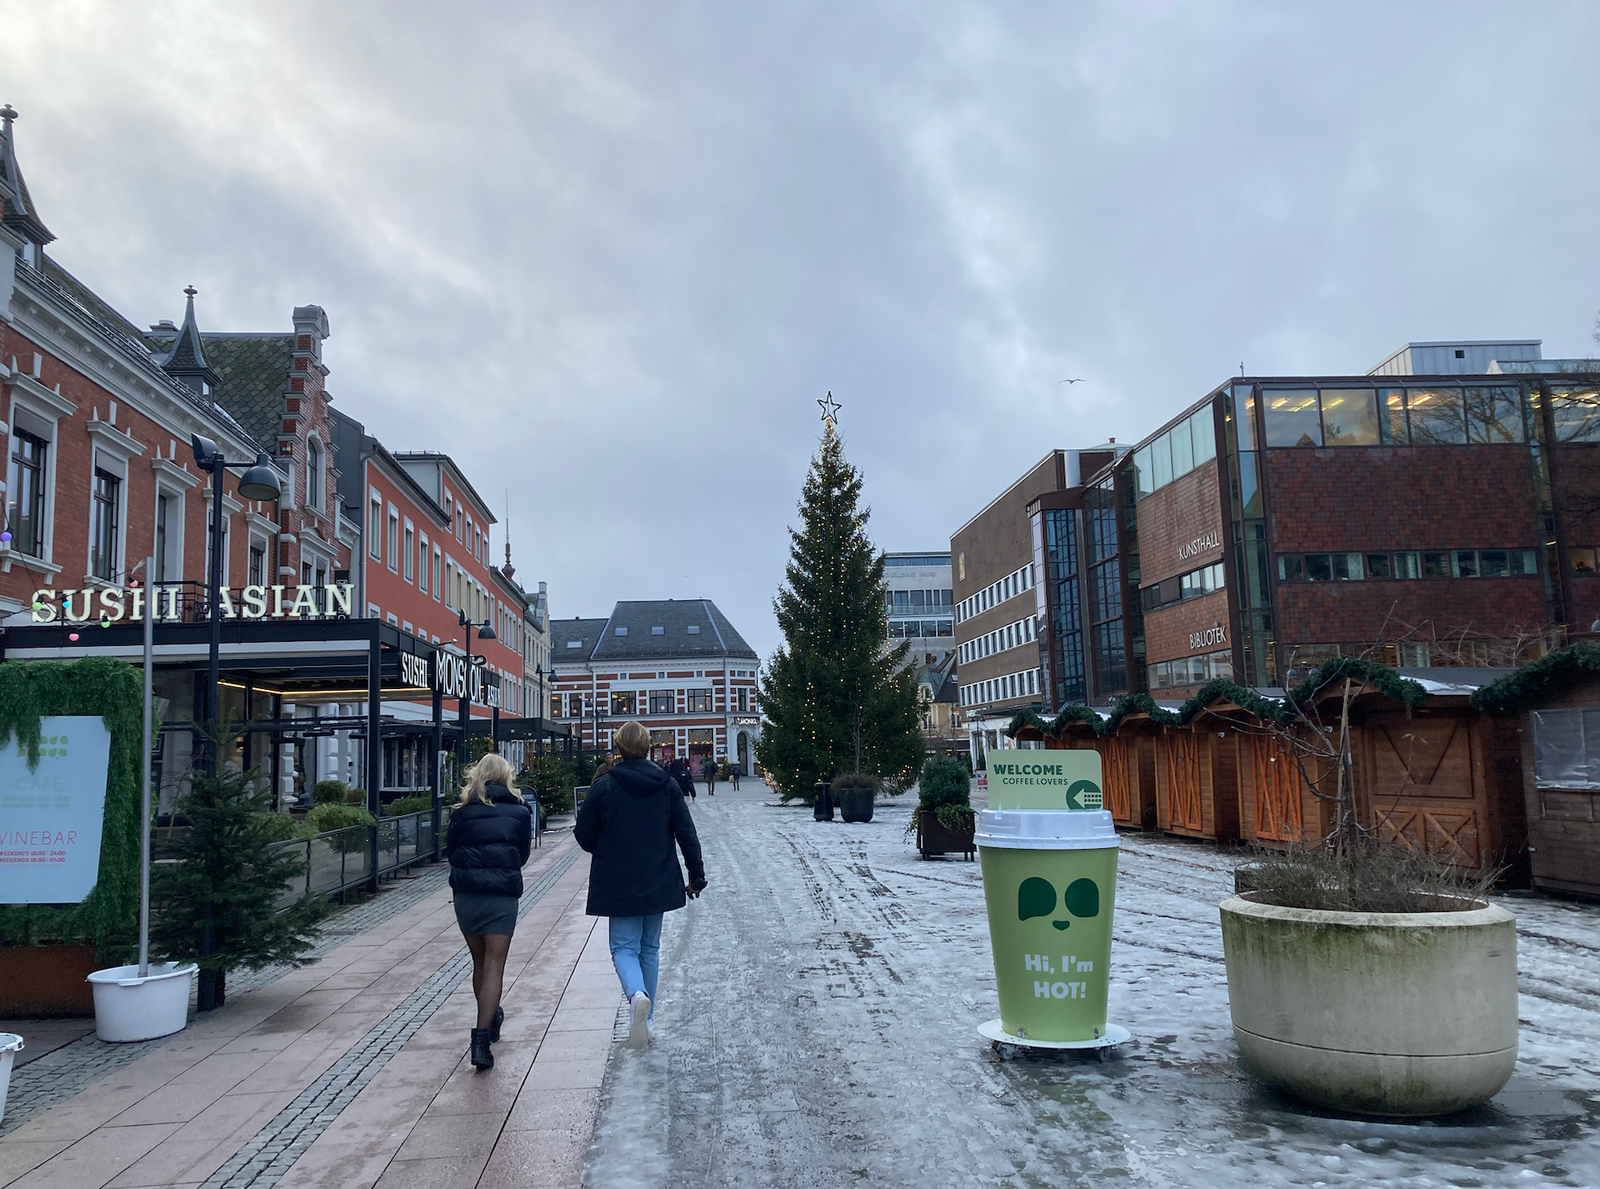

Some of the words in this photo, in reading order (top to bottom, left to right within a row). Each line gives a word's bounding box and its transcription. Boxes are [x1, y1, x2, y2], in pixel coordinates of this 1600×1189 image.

[1179, 531, 1220, 560] KUNSTHALL
[31, 588, 181, 622] SUSHI
[207, 584, 355, 619] ASIAN
[1189, 626, 1227, 650] BIBLIOTEK
[402, 651, 428, 688] SUSHI
[993, 764, 1063, 775] WELCOME
[1036, 778, 1069, 786] LOVERS
[1024, 953, 1055, 974] Hi,
[1061, 955, 1094, 973] I'm
[1033, 981, 1087, 999] HOT!
